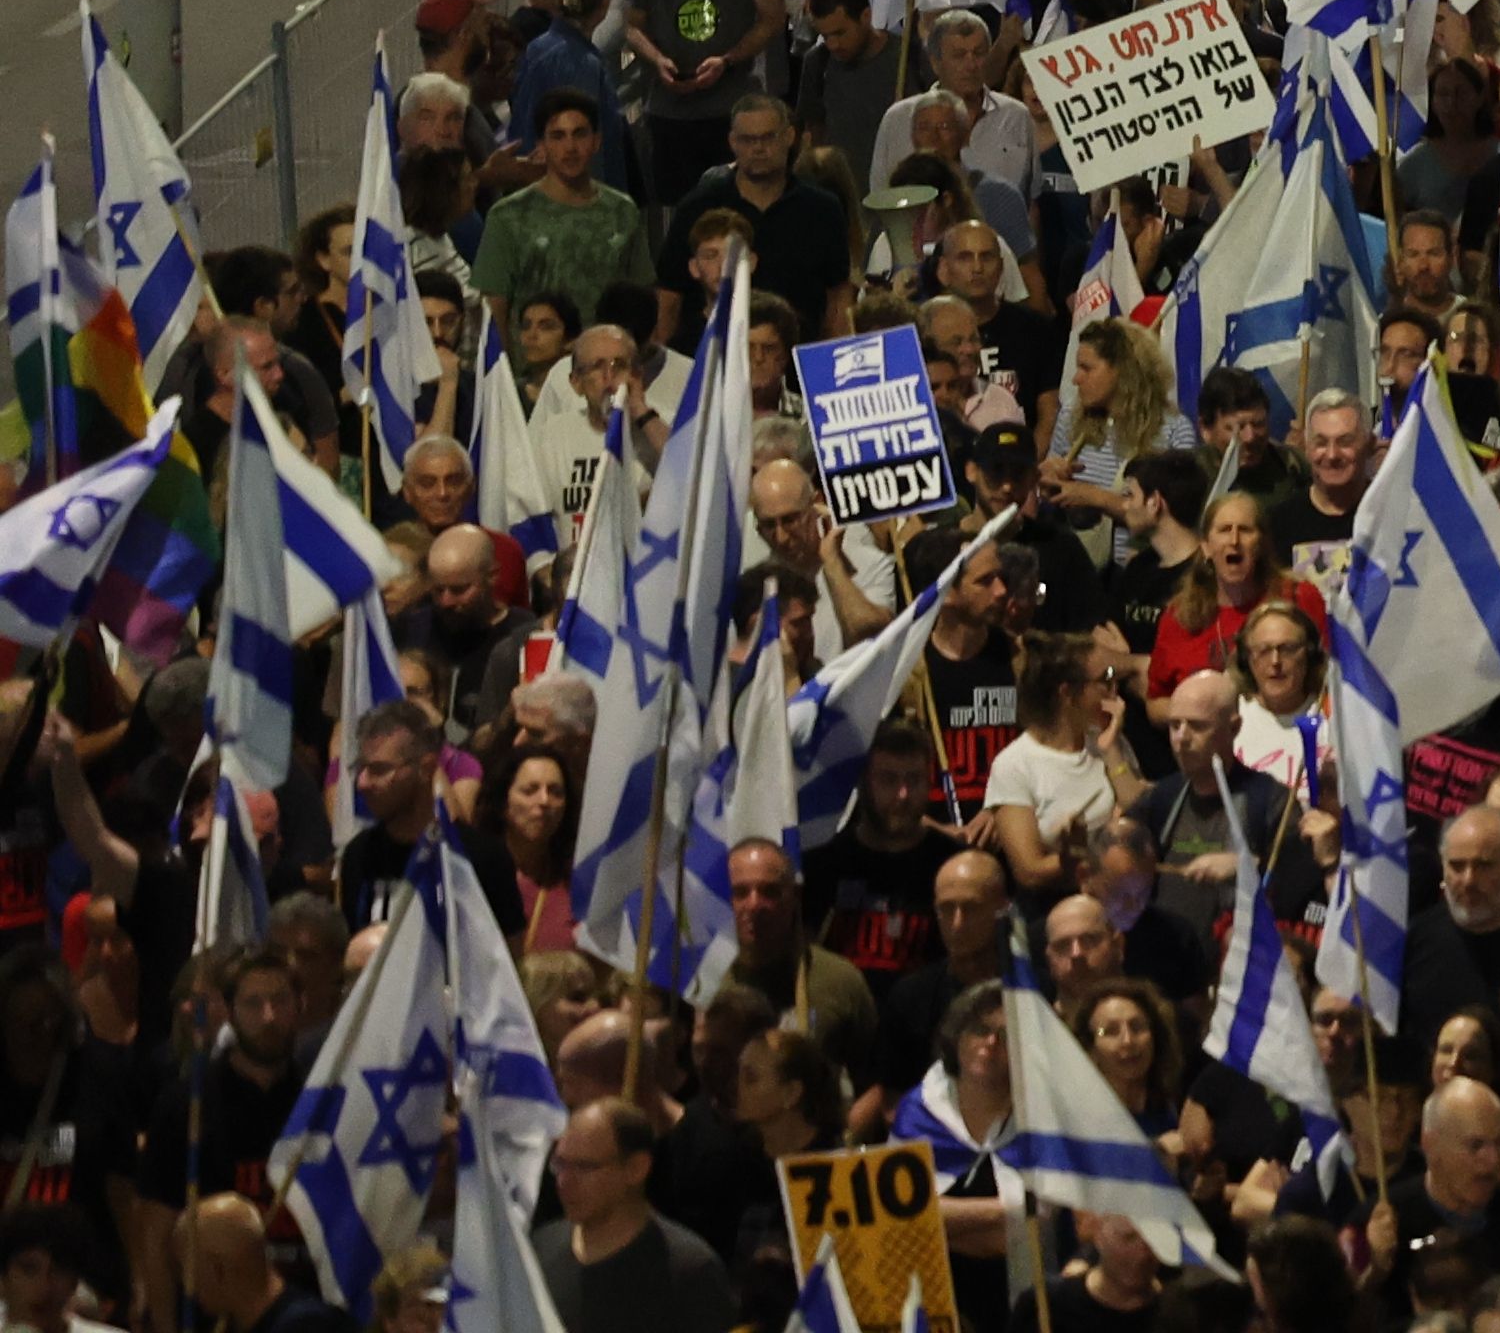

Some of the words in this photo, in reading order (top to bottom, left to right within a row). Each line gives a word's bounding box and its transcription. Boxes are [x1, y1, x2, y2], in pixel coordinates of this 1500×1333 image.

[1040, 44, 1099, 89] גנץ
[1133, 49, 1186, 107] לצד
[1193, 38, 1248, 77] בואו
[1053, 79, 1124, 137] הנכון
[1213, 71, 1257, 114] של
[1071, 95, 1203, 162] ההיסטוריה
[821, 418, 940, 469] בחירות
[788, 1149, 931, 1227] 7.10
